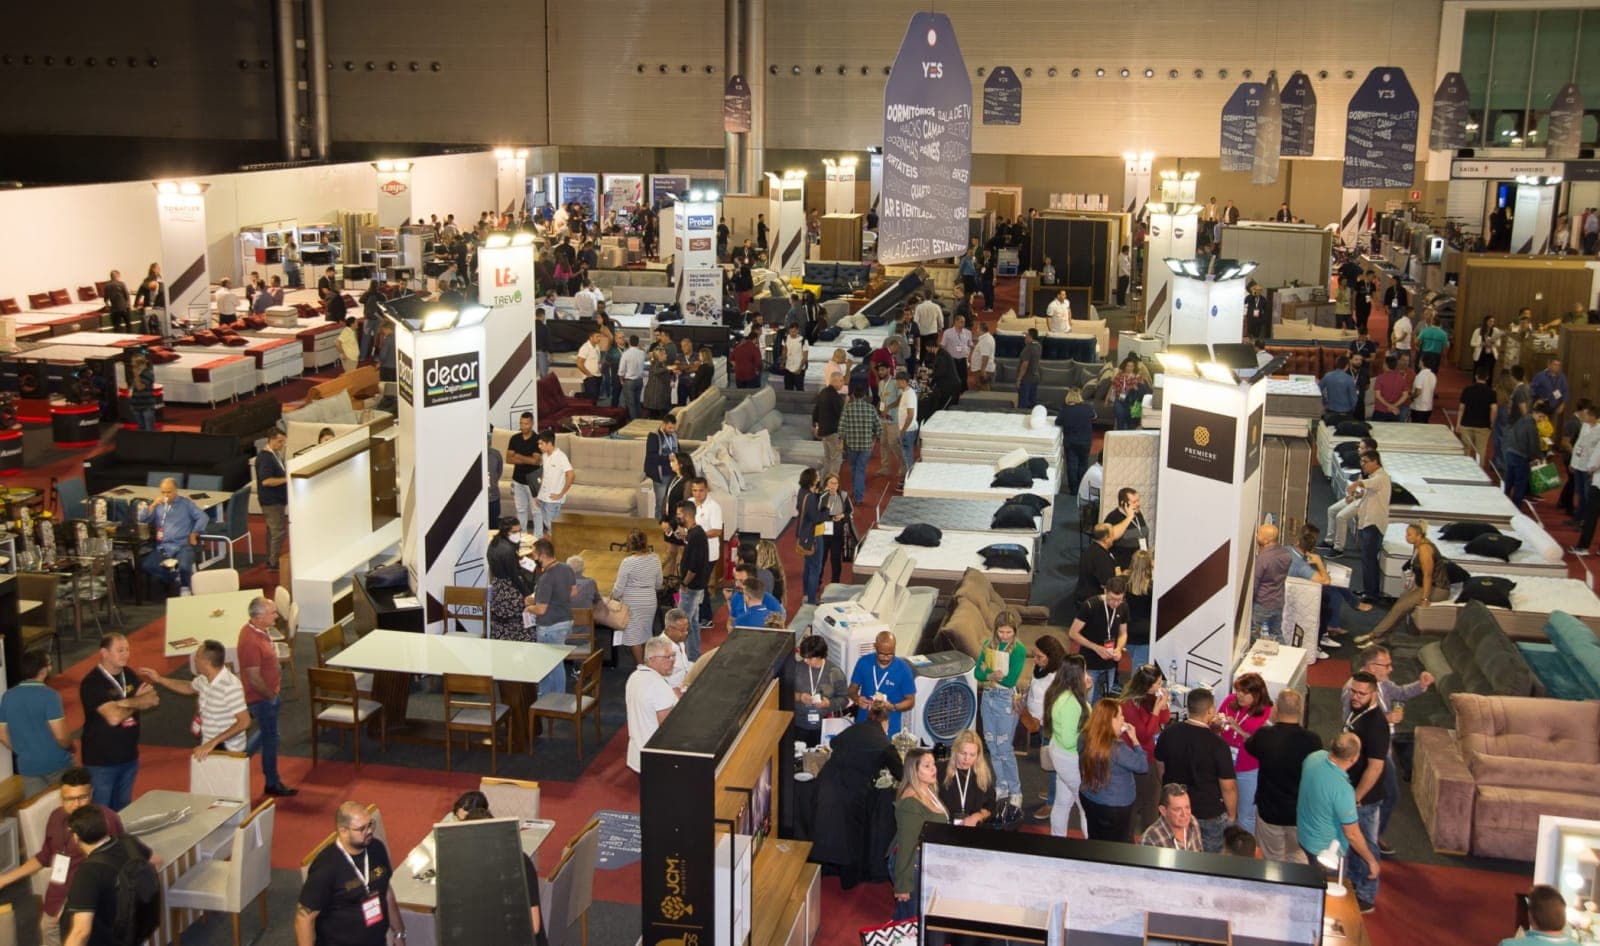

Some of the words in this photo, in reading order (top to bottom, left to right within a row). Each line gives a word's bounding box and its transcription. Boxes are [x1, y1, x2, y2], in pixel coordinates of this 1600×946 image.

[922, 61, 943, 78] YES
[1378, 90, 1396, 98] YES
[1246, 99, 1260, 107] YES
[887, 104, 936, 122] DORMITÓRIOS
[922, 119, 945, 139] CAMAS
[884, 197, 895, 217] AR
[895, 200, 901, 217] E
[689, 216, 713, 227] Probel
[493, 293, 522, 304] TREVO
[427, 360, 478, 387] decor
[1184, 446, 1217, 460] PREMIERE
[666, 857, 680, 895] JCM
